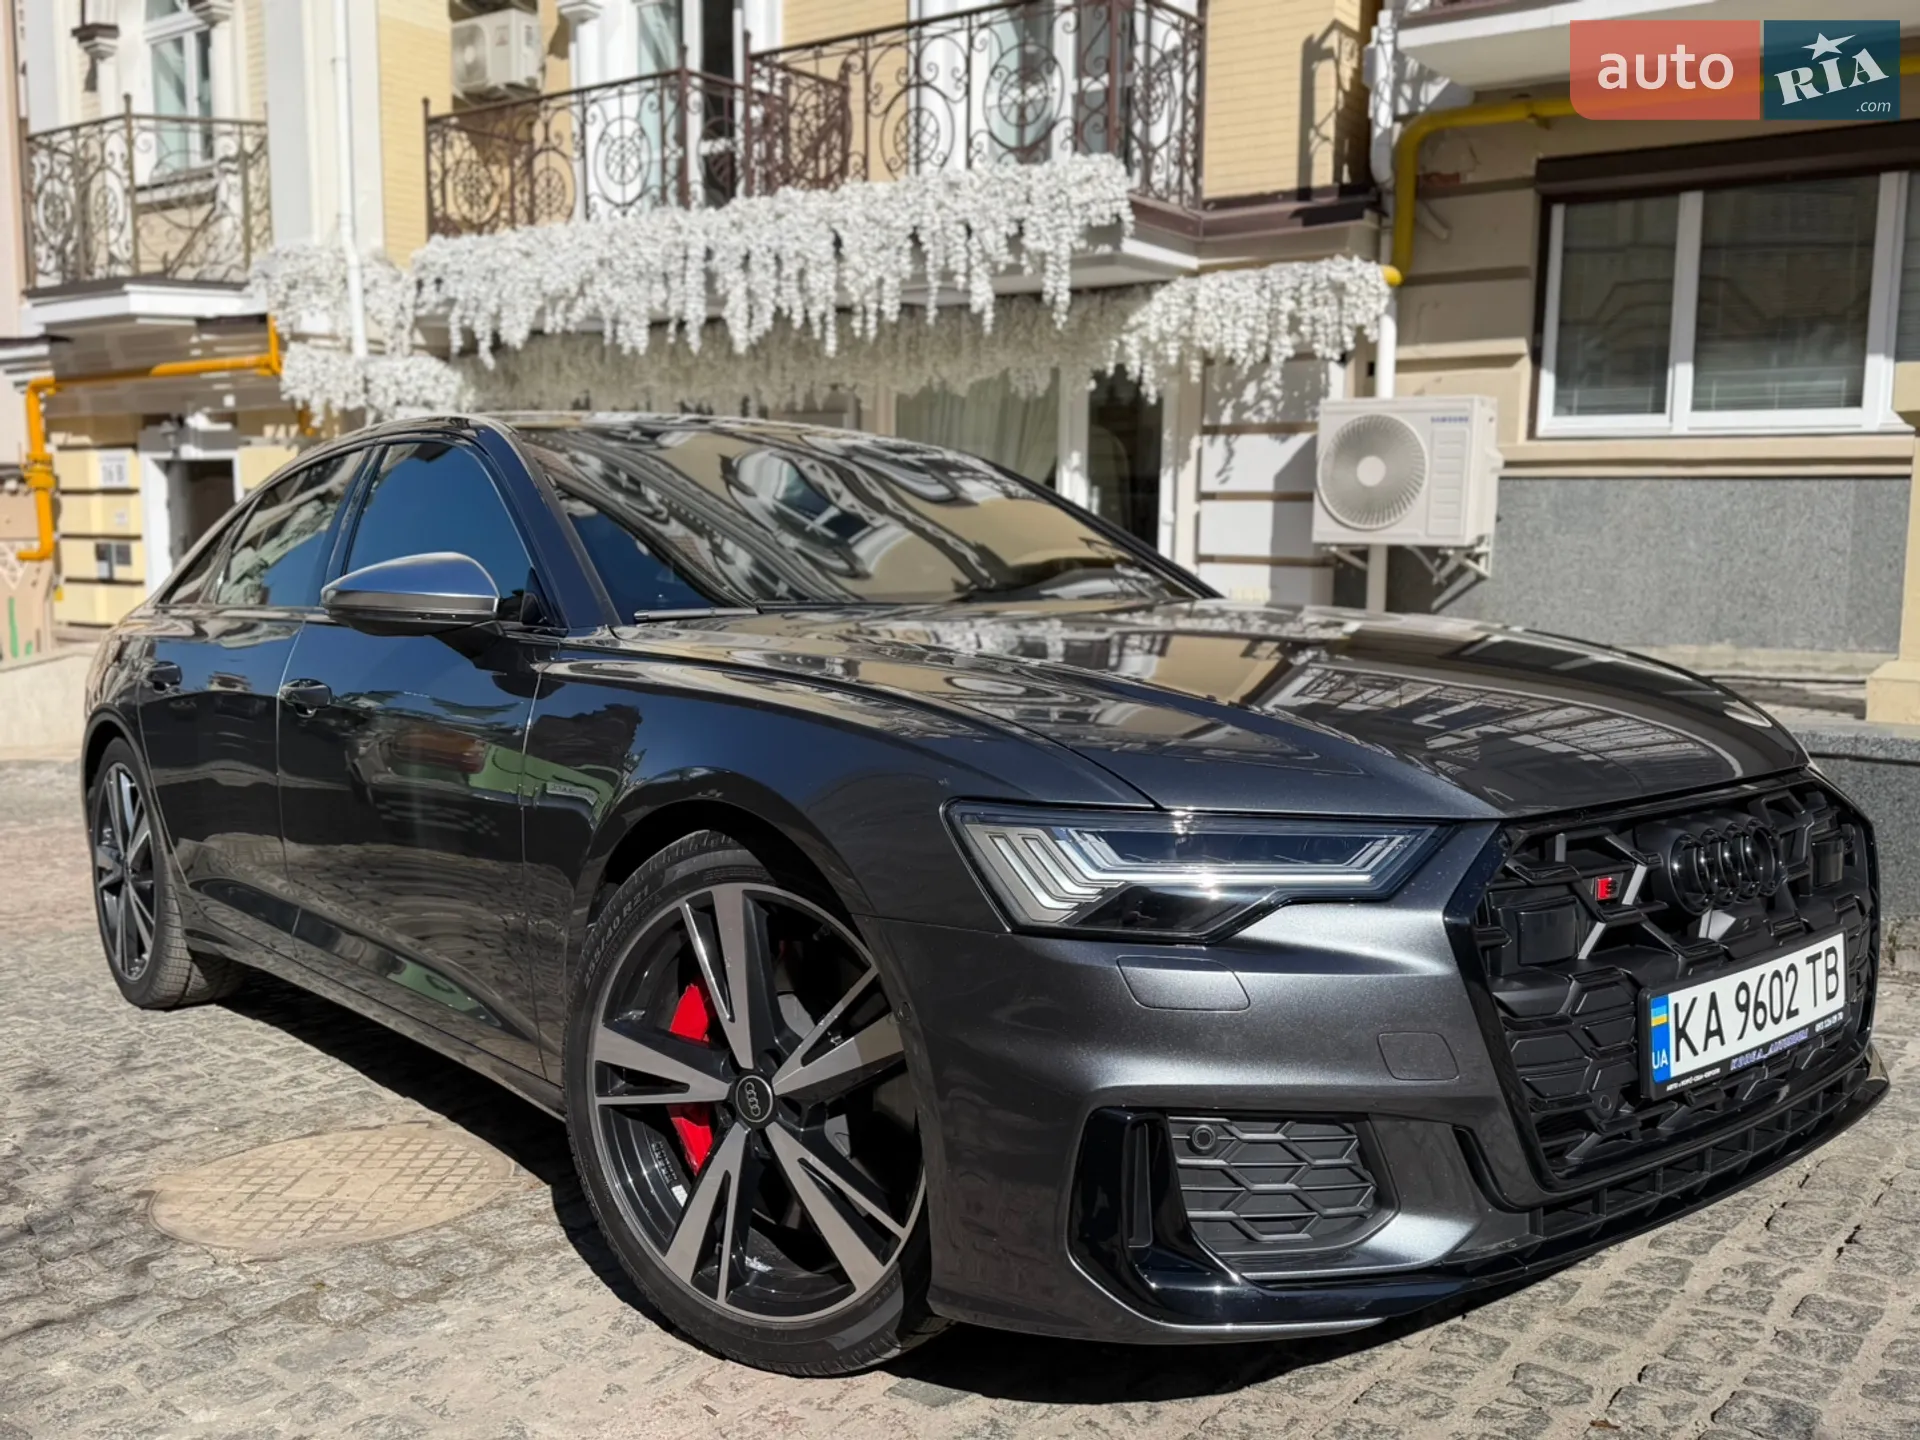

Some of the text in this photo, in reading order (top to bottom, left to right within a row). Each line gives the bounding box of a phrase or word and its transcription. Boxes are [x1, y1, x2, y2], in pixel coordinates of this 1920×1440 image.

[623, 885, 649, 917] R21
[1673, 991, 1726, 1063] KA
[1735, 962, 1800, 1042] 9602
[1805, 945, 1840, 1009] TB
[1652, 1050, 1669, 1070] UA
